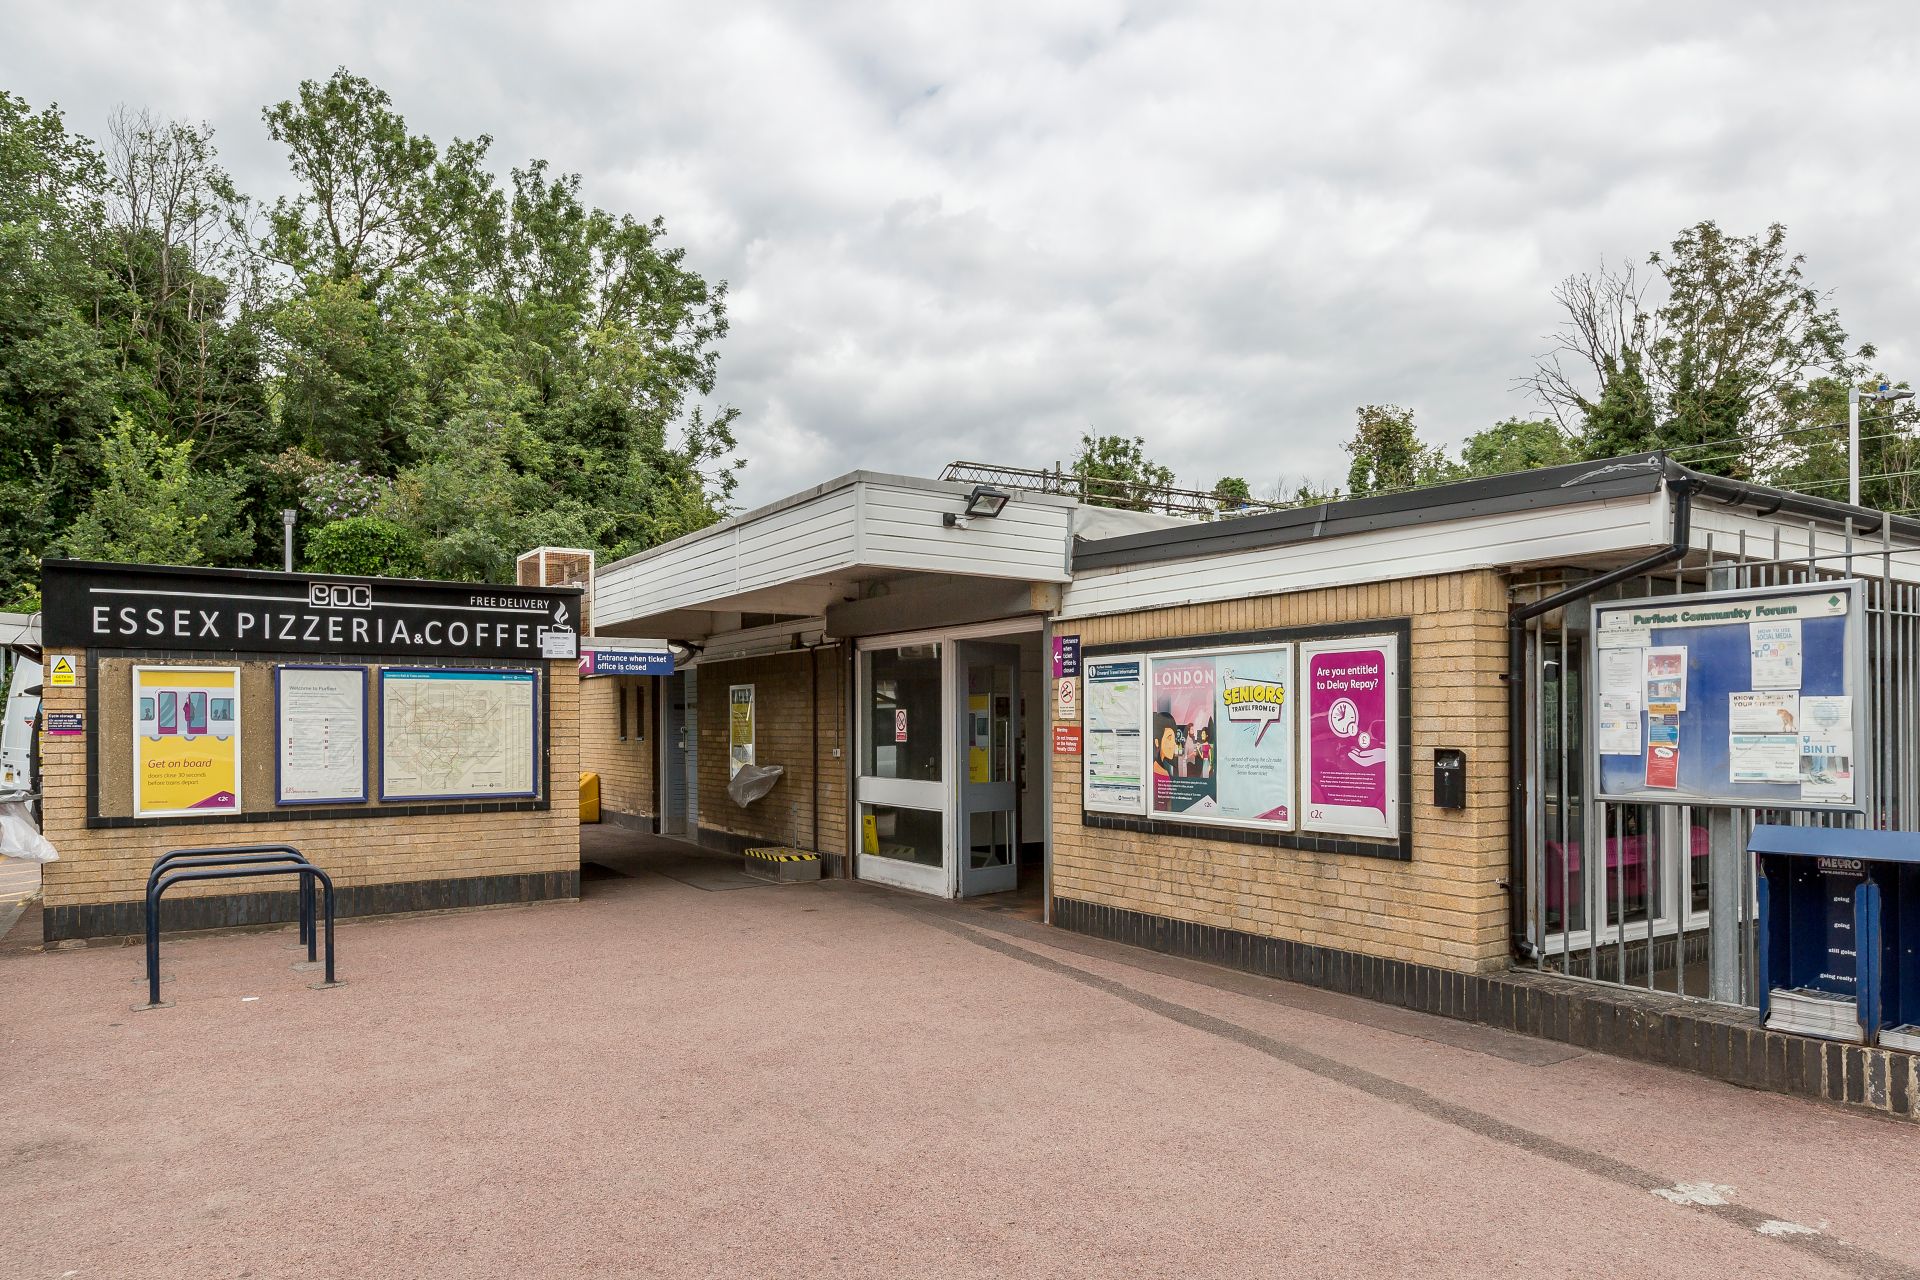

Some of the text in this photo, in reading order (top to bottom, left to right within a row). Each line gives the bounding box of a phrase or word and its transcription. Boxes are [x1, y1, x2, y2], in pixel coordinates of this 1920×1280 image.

[470, 595, 550, 609] FREE DELIVERY
[1633, 604, 1797, 625] Purfleet Community Forum
[92, 605, 220, 638] ESSEX
[597, 653, 667, 663] Entrance when ticket
[597, 662, 647, 671] office is closed
[1316, 664, 1378, 678] Are you entitled
[1154, 669, 1214, 686] LONDON
[1316, 678, 1379, 691] to Delay Repay?
[1223, 685, 1285, 706] SENIORS
[1231, 705, 1251, 713] TRAVEL
[1251, 704, 1268, 712] FROM
[1803, 745, 1837, 754] BIN IT
[147, 759, 166, 769] Get
[183, 758, 212, 768] board
[1310, 809, 1324, 819] c2c
[1821, 857, 1862, 870] METRO
[1833, 922, 1850, 930] going
[1840, 949, 1857, 957] going
[1819, 972, 1836, 980] going
[1836, 974, 1853, 983] really
